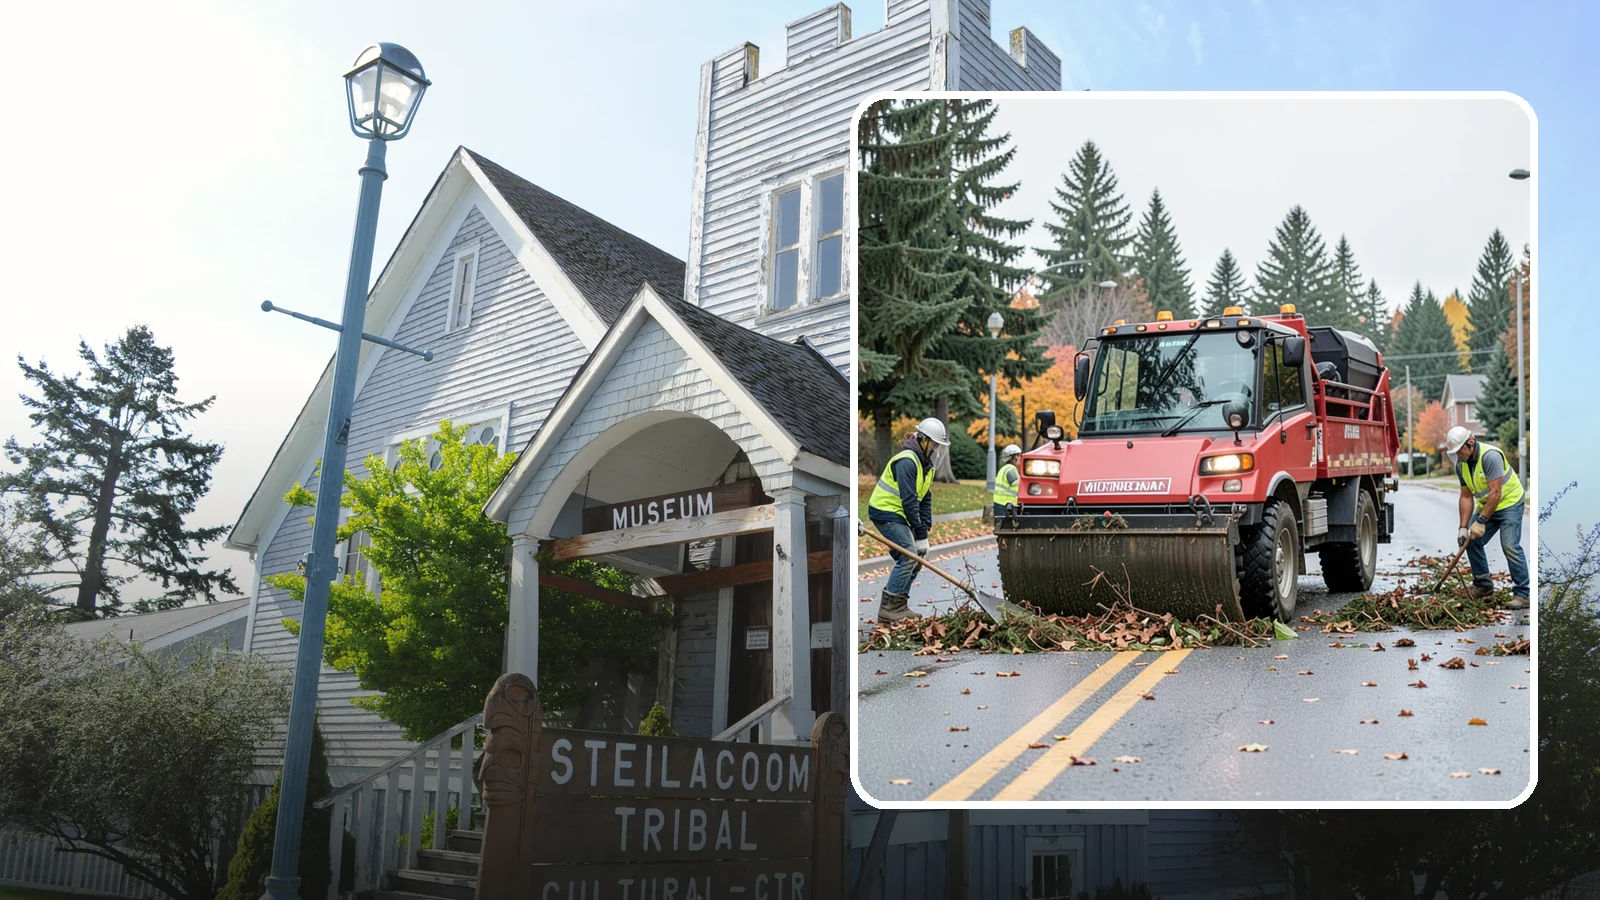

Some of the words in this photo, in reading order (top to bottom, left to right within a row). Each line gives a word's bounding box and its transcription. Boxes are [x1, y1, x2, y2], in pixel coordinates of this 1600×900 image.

[613, 491, 714, 531] MUSEUM
[551, 738, 809, 793] STEILACOOM
[615, 806, 757, 851] TRIBAL
